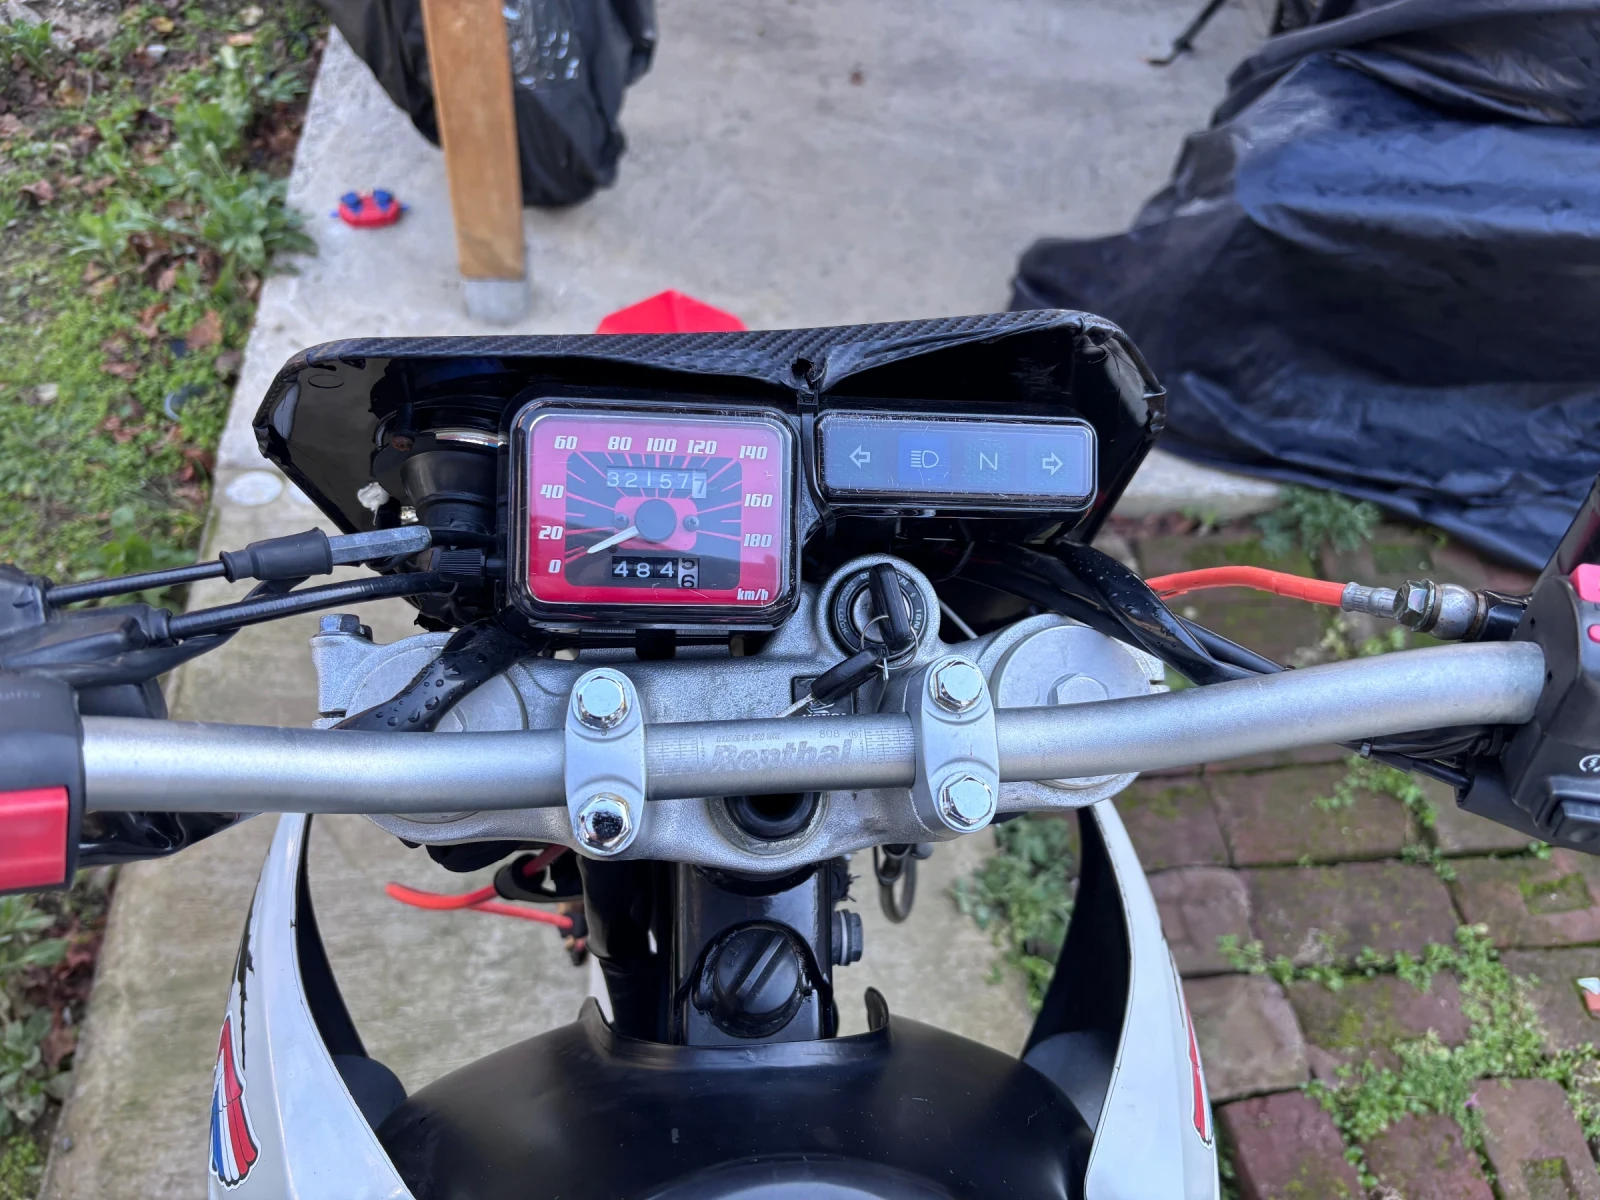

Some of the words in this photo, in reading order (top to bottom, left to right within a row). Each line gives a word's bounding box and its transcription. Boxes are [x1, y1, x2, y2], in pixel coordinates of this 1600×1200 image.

[554, 435, 578, 450] 60
[607, 436, 632, 451] 80
[646, 437, 678, 453] 100
[687, 439, 718, 455] 120
[739, 445, 768, 460] 140
[979, 452, 998, 471] N
[540, 484, 565, 499] 40
[744, 493, 773, 508] 160
[538, 525, 564, 540] 20
[743, 533, 773, 548] 180
[548, 559, 562, 573] 0
[737, 587, 769, 601] km/h
[838, 609, 849, 635] LOCK
[711, 738, 853, 773] Renthal
